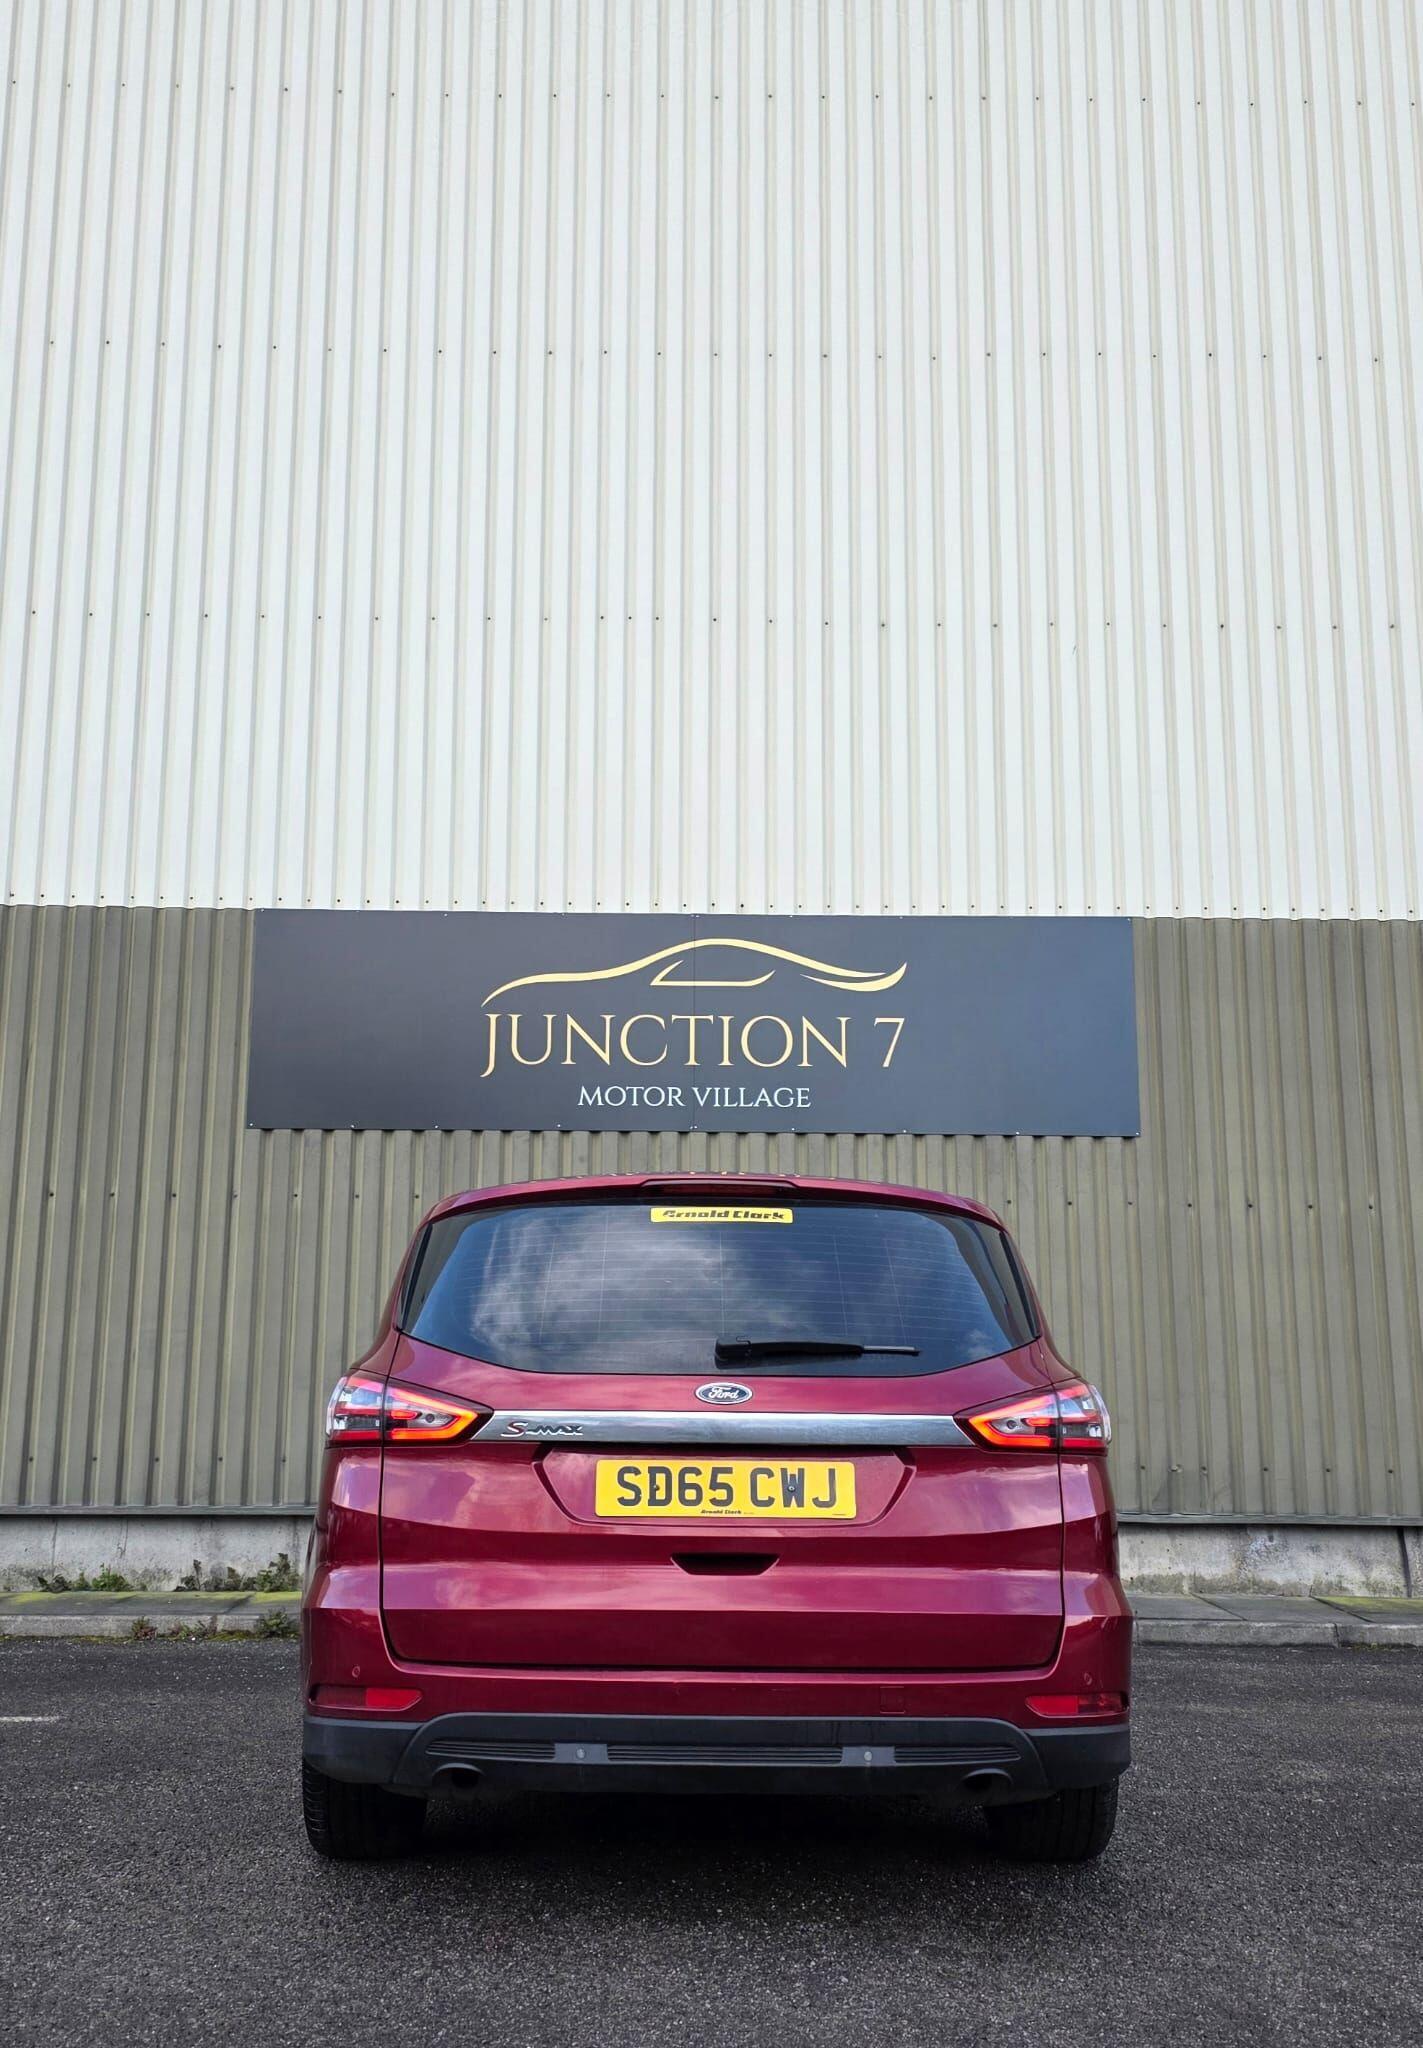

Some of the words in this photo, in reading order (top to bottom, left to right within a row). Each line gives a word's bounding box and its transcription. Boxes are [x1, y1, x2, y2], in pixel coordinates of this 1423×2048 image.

[480, 1013, 852, 1077] JUNCTION
[873, 1016, 905, 1068] 7
[577, 1085, 687, 1107] MOTOR
[690, 1086, 812, 1108] VILLAGE
[662, 1209, 730, 1218] Arnold
[732, 1210, 784, 1220] Clark
[708, 1386, 740, 1399] Ford
[617, 1466, 734, 1507] SD65
[750, 1467, 836, 1508] CWJ
